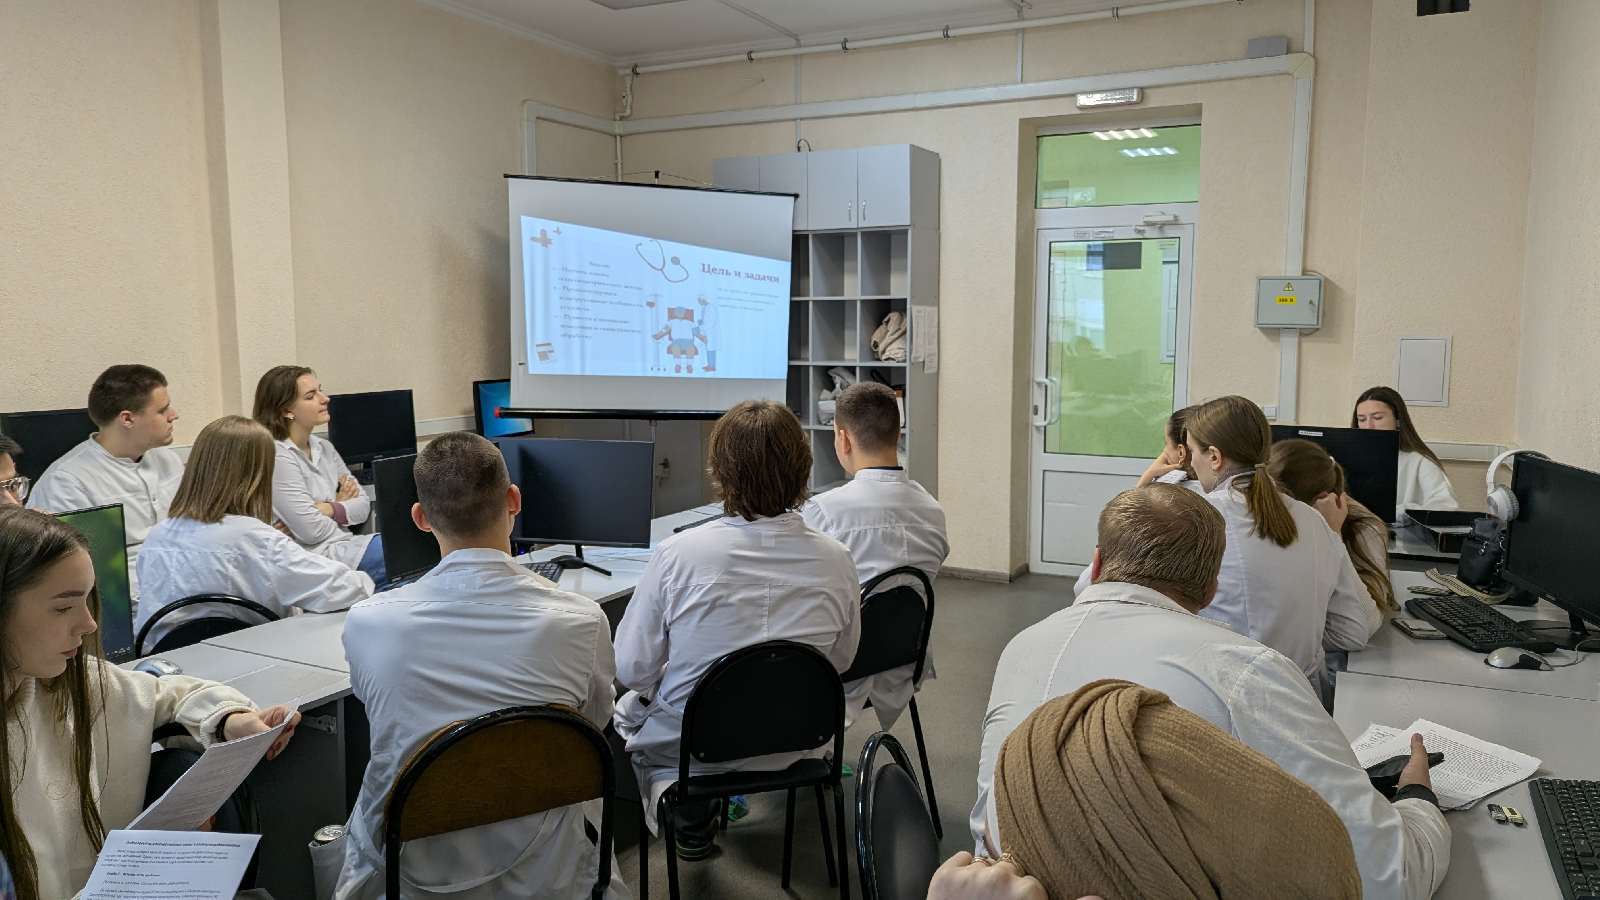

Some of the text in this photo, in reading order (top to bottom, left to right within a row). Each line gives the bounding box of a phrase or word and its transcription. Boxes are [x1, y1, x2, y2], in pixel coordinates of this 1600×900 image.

[701, 262, 780, 283] Цель и задачи
